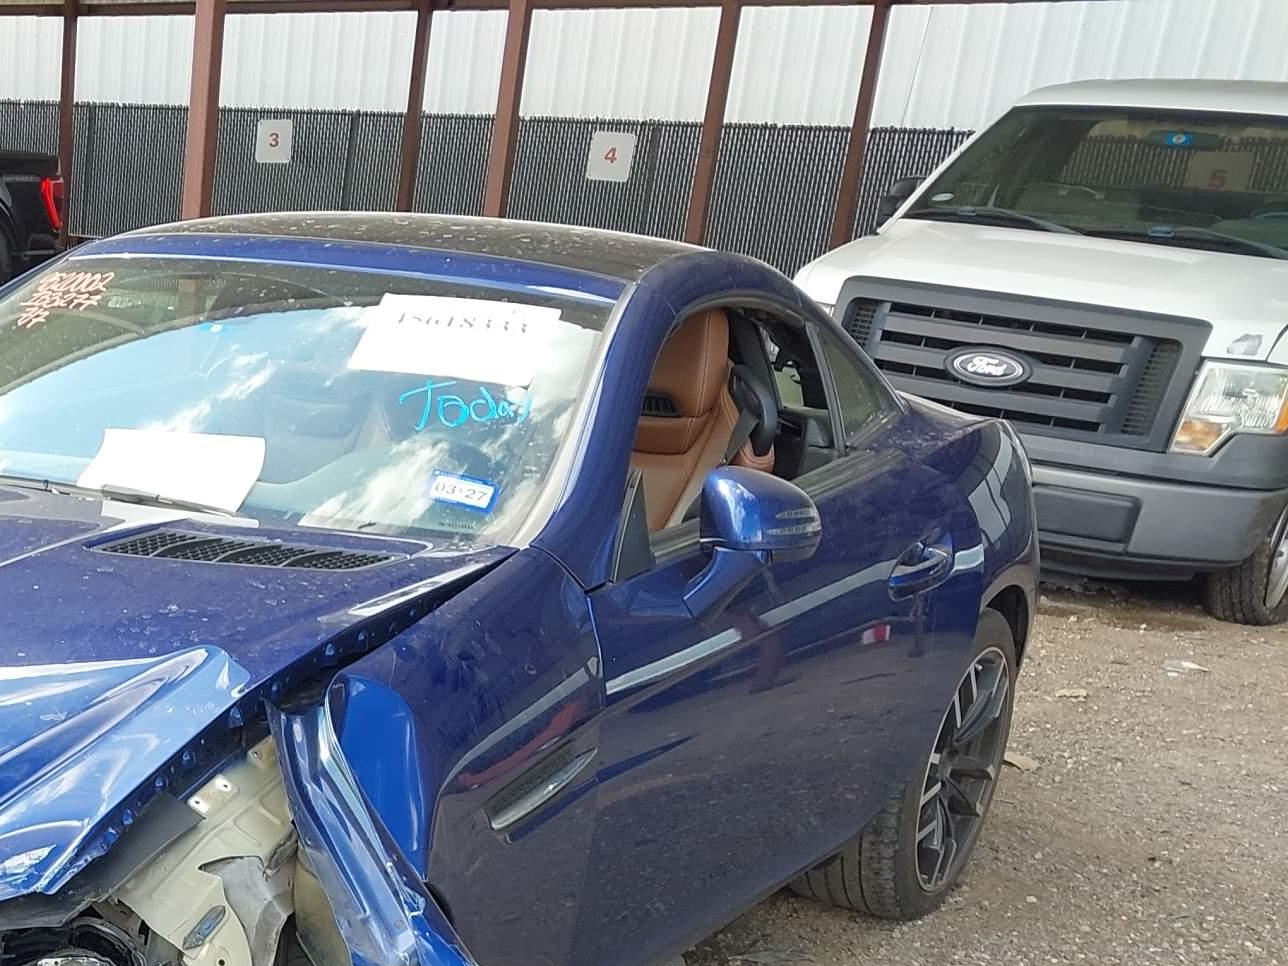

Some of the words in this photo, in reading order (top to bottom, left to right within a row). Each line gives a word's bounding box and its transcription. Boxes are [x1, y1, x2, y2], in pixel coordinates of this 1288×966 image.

[269, 132, 280, 148] 3
[604, 147, 617, 164] 4
[967, 356, 1008, 376] Ford
